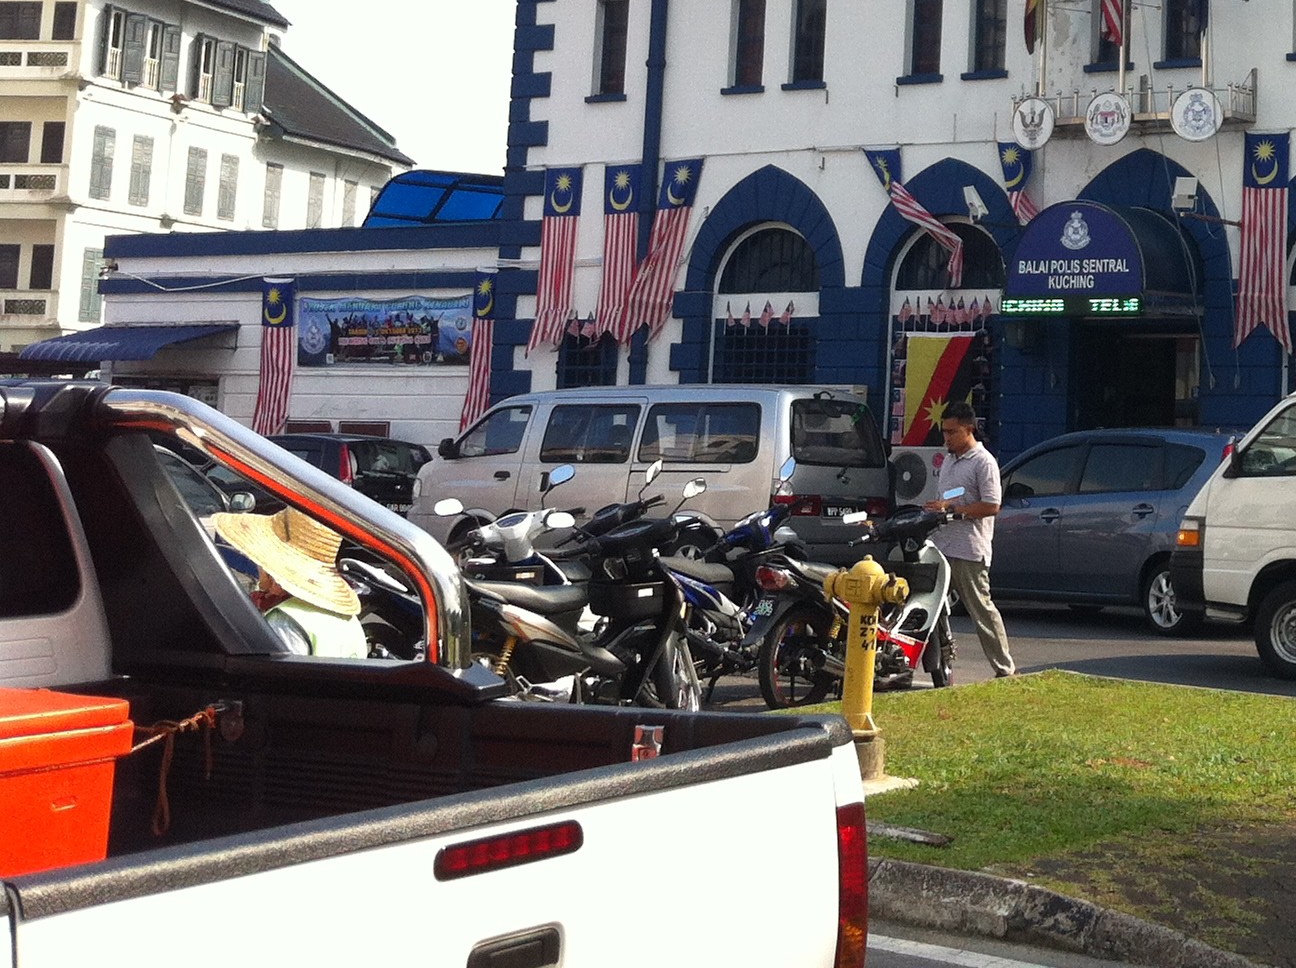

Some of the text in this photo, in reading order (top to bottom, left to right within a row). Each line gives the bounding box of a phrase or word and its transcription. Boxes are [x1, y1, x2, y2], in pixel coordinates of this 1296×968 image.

[1018, 258, 1129, 274] BALAI POLIS SENTRAL
[1048, 275, 1095, 290] KUCHING
